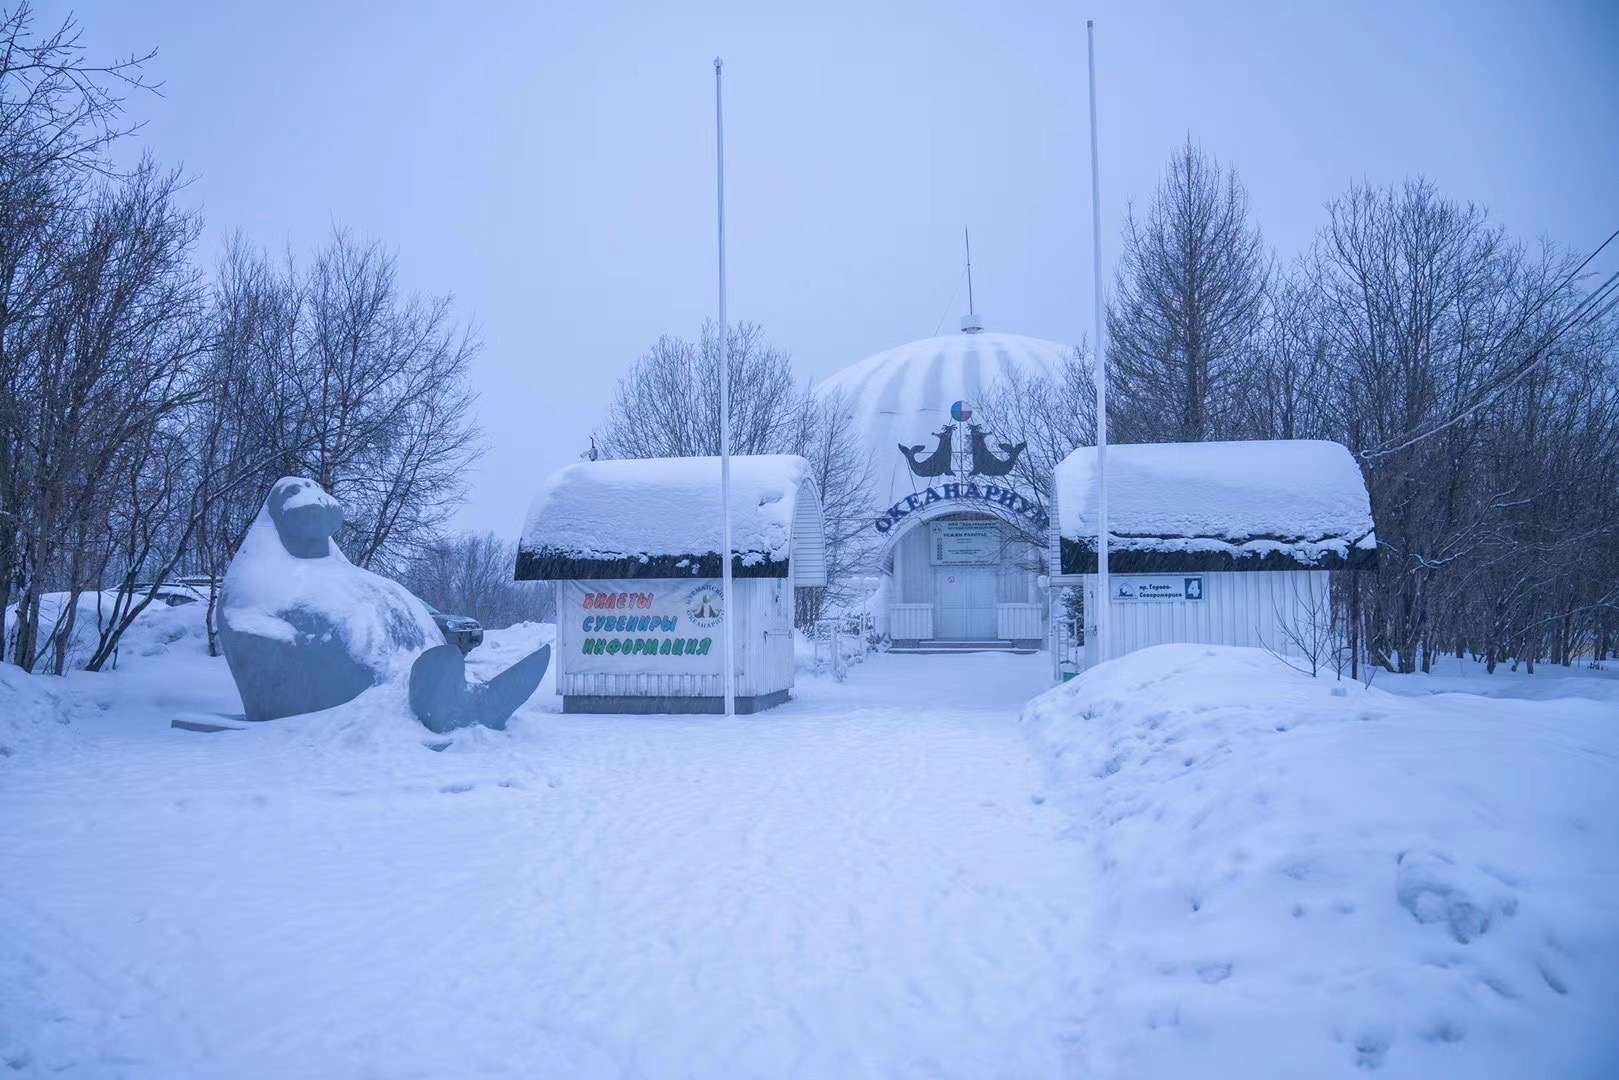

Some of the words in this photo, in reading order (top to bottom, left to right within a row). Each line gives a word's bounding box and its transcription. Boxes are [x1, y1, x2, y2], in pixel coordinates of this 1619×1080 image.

[875, 482, 1050, 533] ОКЕАНАРИУМ
[1187, 580, 1200, 597] 4
[583, 593, 653, 609] БИЛЕТЫ
[582, 615, 678, 632] СУВЕНИРЫ
[582, 637, 712, 656] ИНФОРМАЦИЯ
